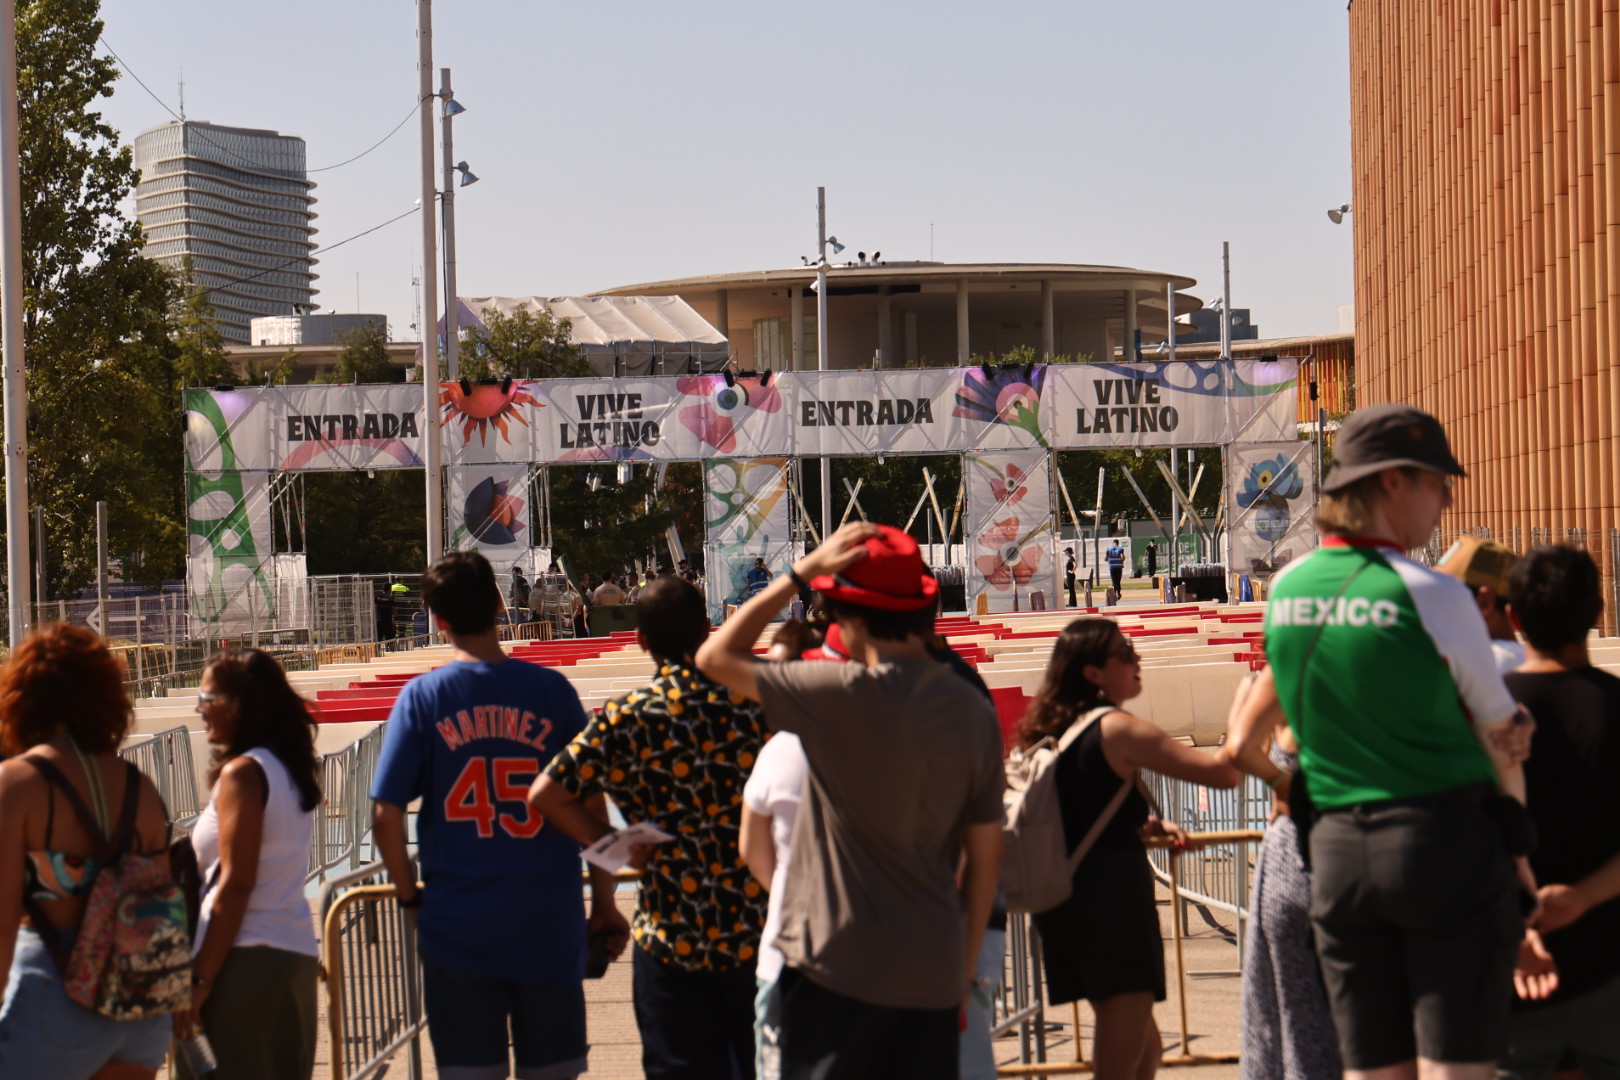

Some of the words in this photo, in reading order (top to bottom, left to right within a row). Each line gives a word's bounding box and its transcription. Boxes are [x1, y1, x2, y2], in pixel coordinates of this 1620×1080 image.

[1093, 378, 1161, 405] VIVE
[576, 393, 643, 420] VIVE
[801, 398, 934, 426] ENTRADA
[1076, 405, 1179, 434] LATINO
[287, 412, 419, 441] ENTRADA
[560, 421, 660, 448] LATINO
[1271, 597, 1399, 629] MEXICO
[436, 705, 553, 751] MARTINEZ
[444, 757, 544, 838] 45
